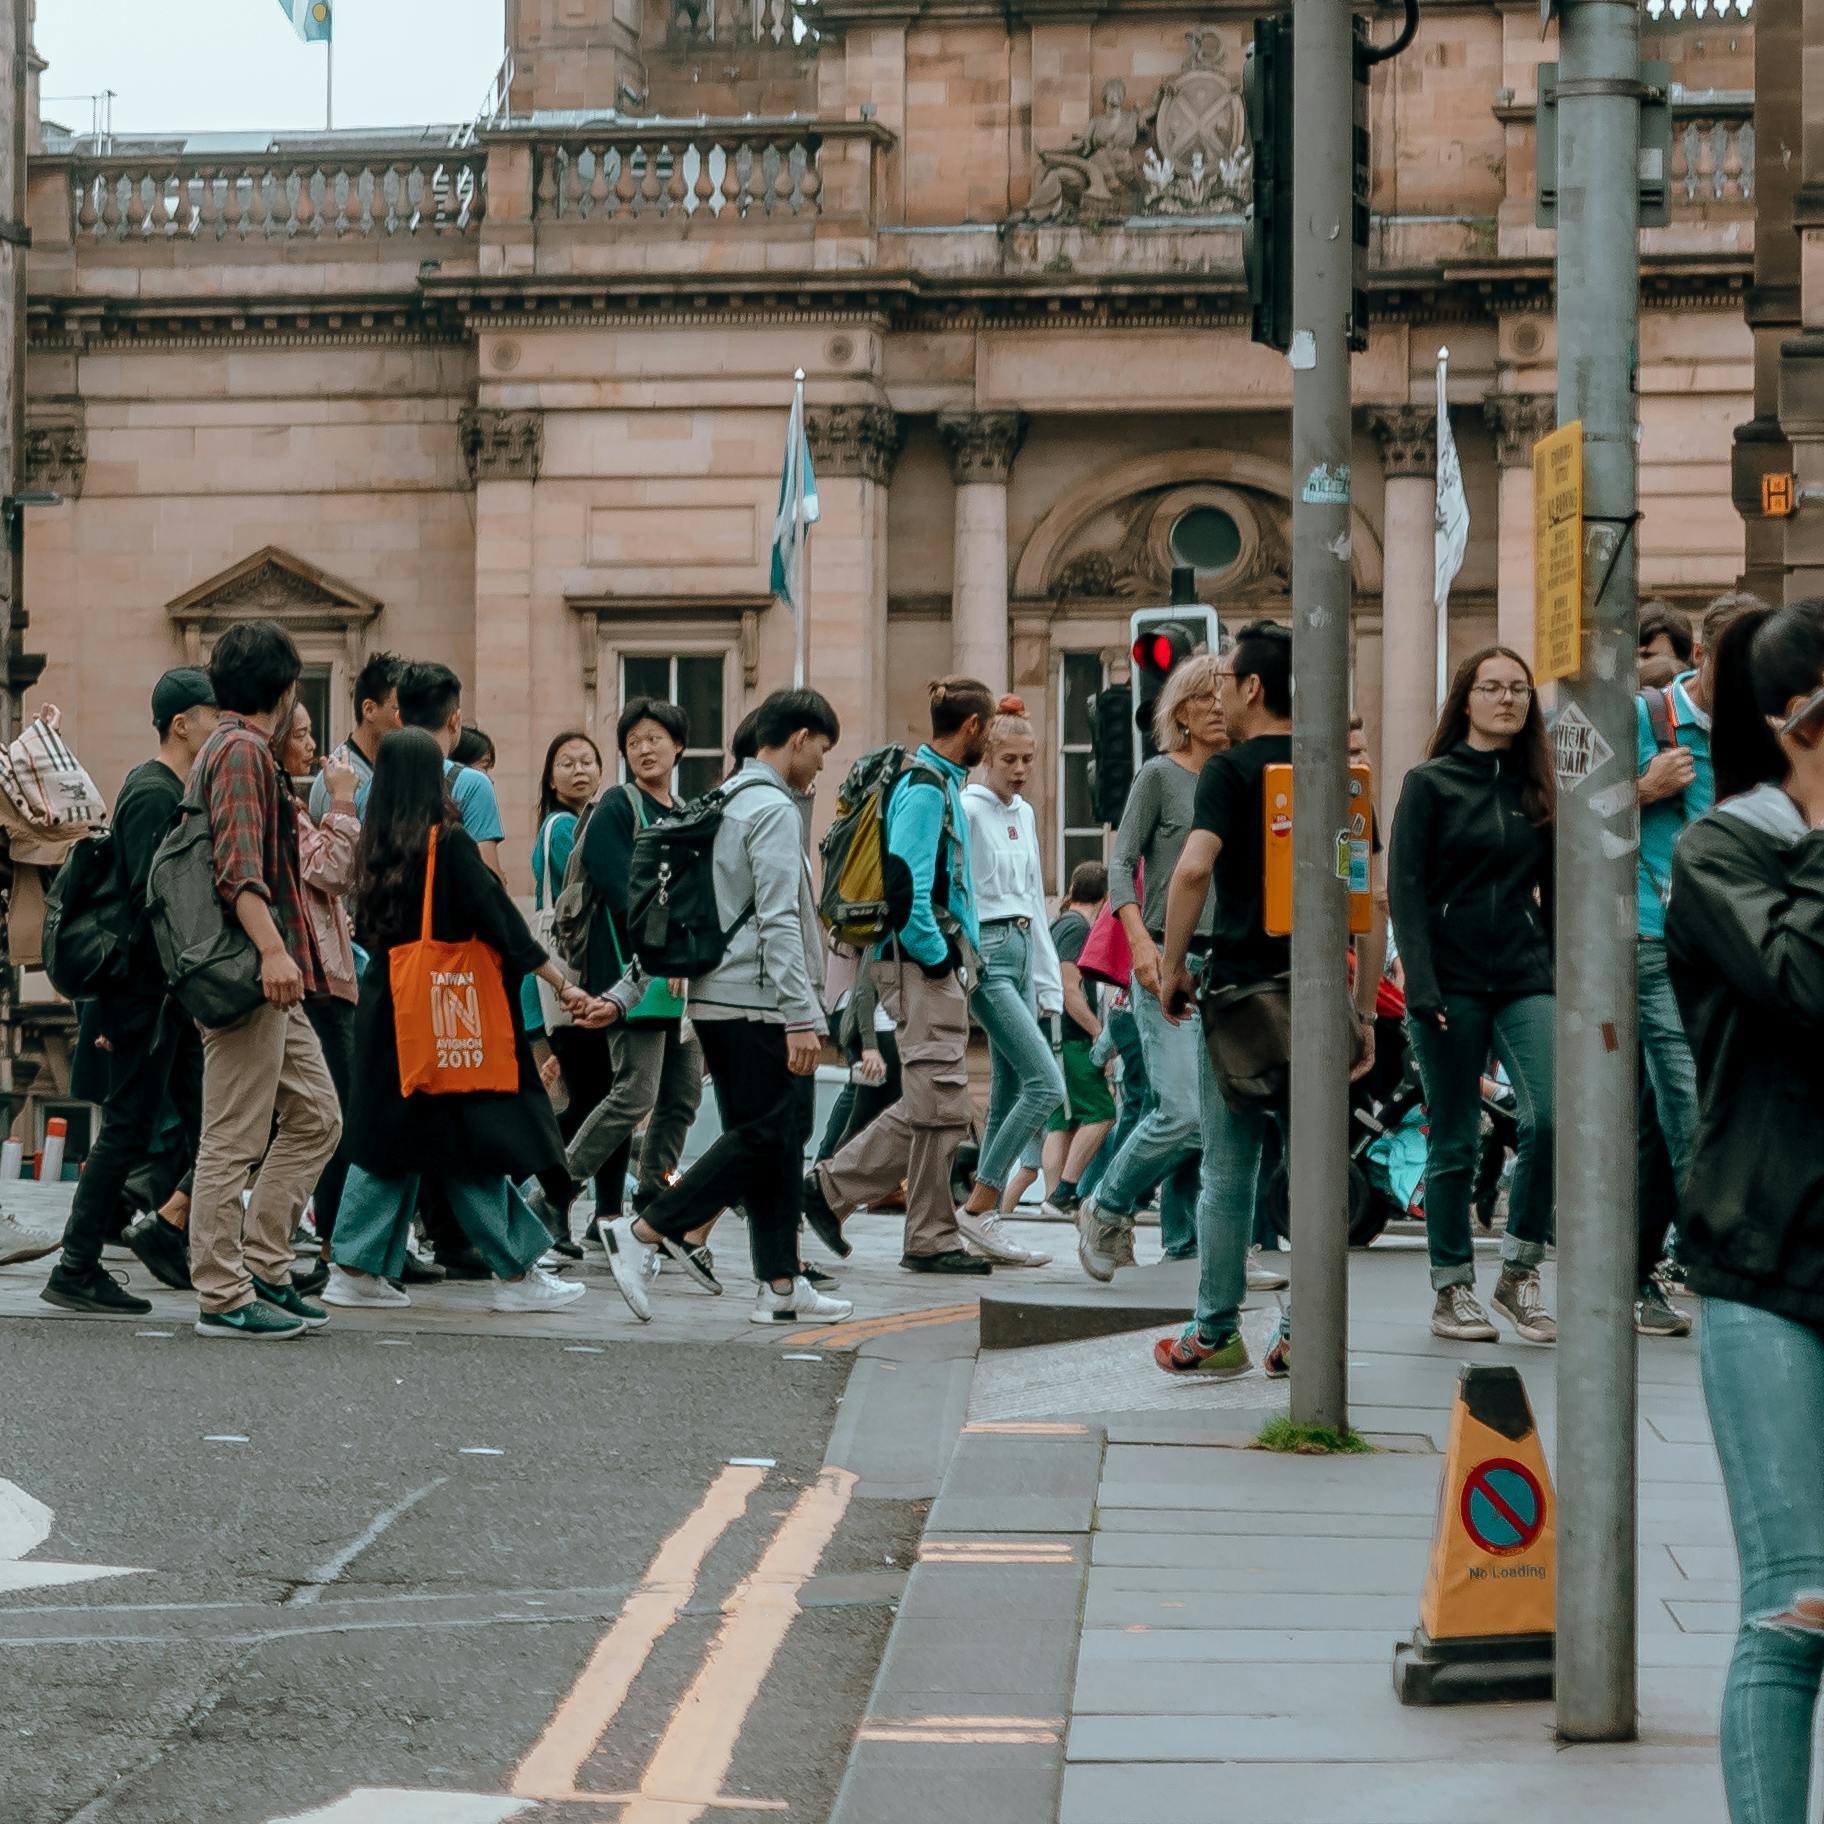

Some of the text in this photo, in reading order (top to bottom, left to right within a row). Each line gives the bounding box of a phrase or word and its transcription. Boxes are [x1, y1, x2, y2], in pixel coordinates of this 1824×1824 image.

[430, 970, 474, 986] TAIWAN
[430, 985, 482, 1038] IN
[437, 1048, 484, 1069] 2019
[1468, 1564, 1547, 1580] No Loading
